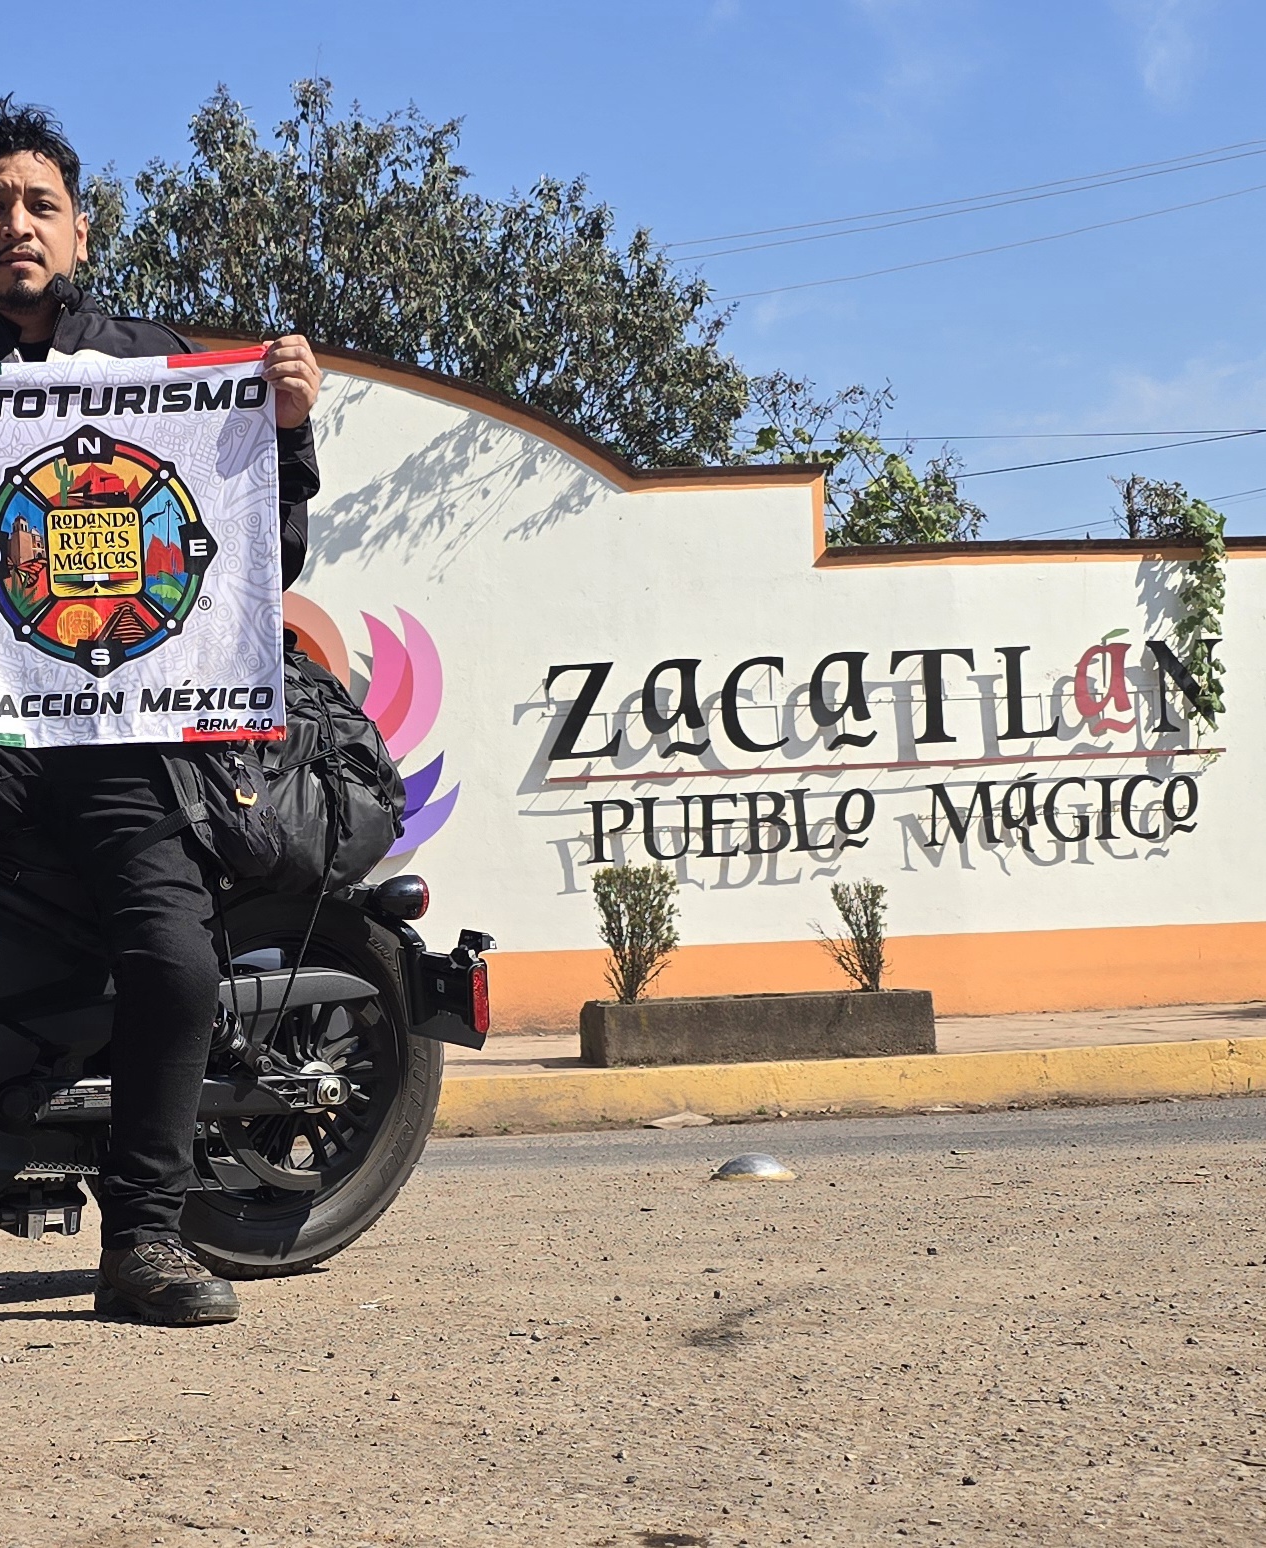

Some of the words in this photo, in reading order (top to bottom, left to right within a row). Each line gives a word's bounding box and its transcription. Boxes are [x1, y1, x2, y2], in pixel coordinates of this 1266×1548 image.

[77, 437, 101, 455] N
[189, 539, 208, 556] E
[91, 648, 110, 667] S
[139, 680, 274, 713] MÉXICO
[195, 718, 238, 731] RRM
[244, 717, 273, 731] 4.0
